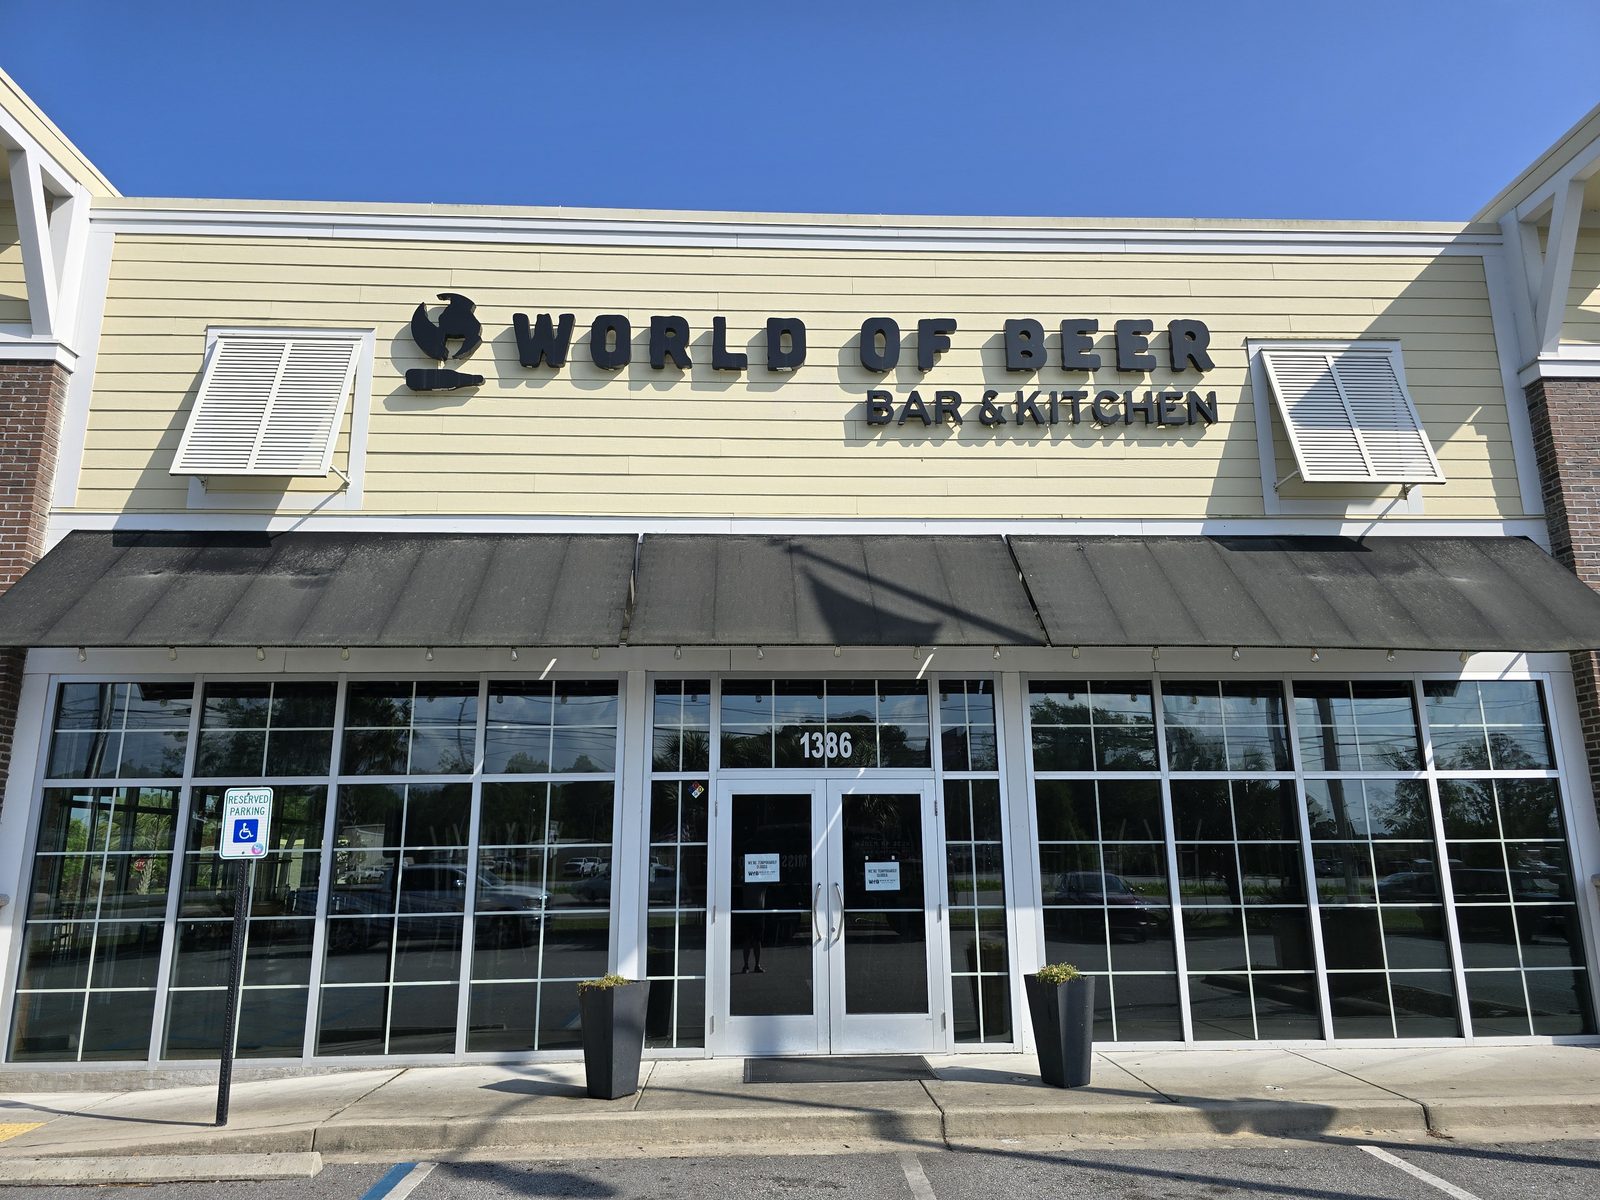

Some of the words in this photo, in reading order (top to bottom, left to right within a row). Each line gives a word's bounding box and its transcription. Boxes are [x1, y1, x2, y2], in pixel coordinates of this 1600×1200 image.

[512, 312, 807, 372] WORLD
[859, 317, 957, 373] OF
[1003, 318, 1215, 373] BEER
[866, 389, 963, 426] BAR
[979, 389, 1007, 425] &
[1016, 389, 1218, 427] KITCHEN
[800, 731, 853, 758] 1386
[228, 794, 269, 805] RESERVED
[229, 806, 266, 816] PARKING
